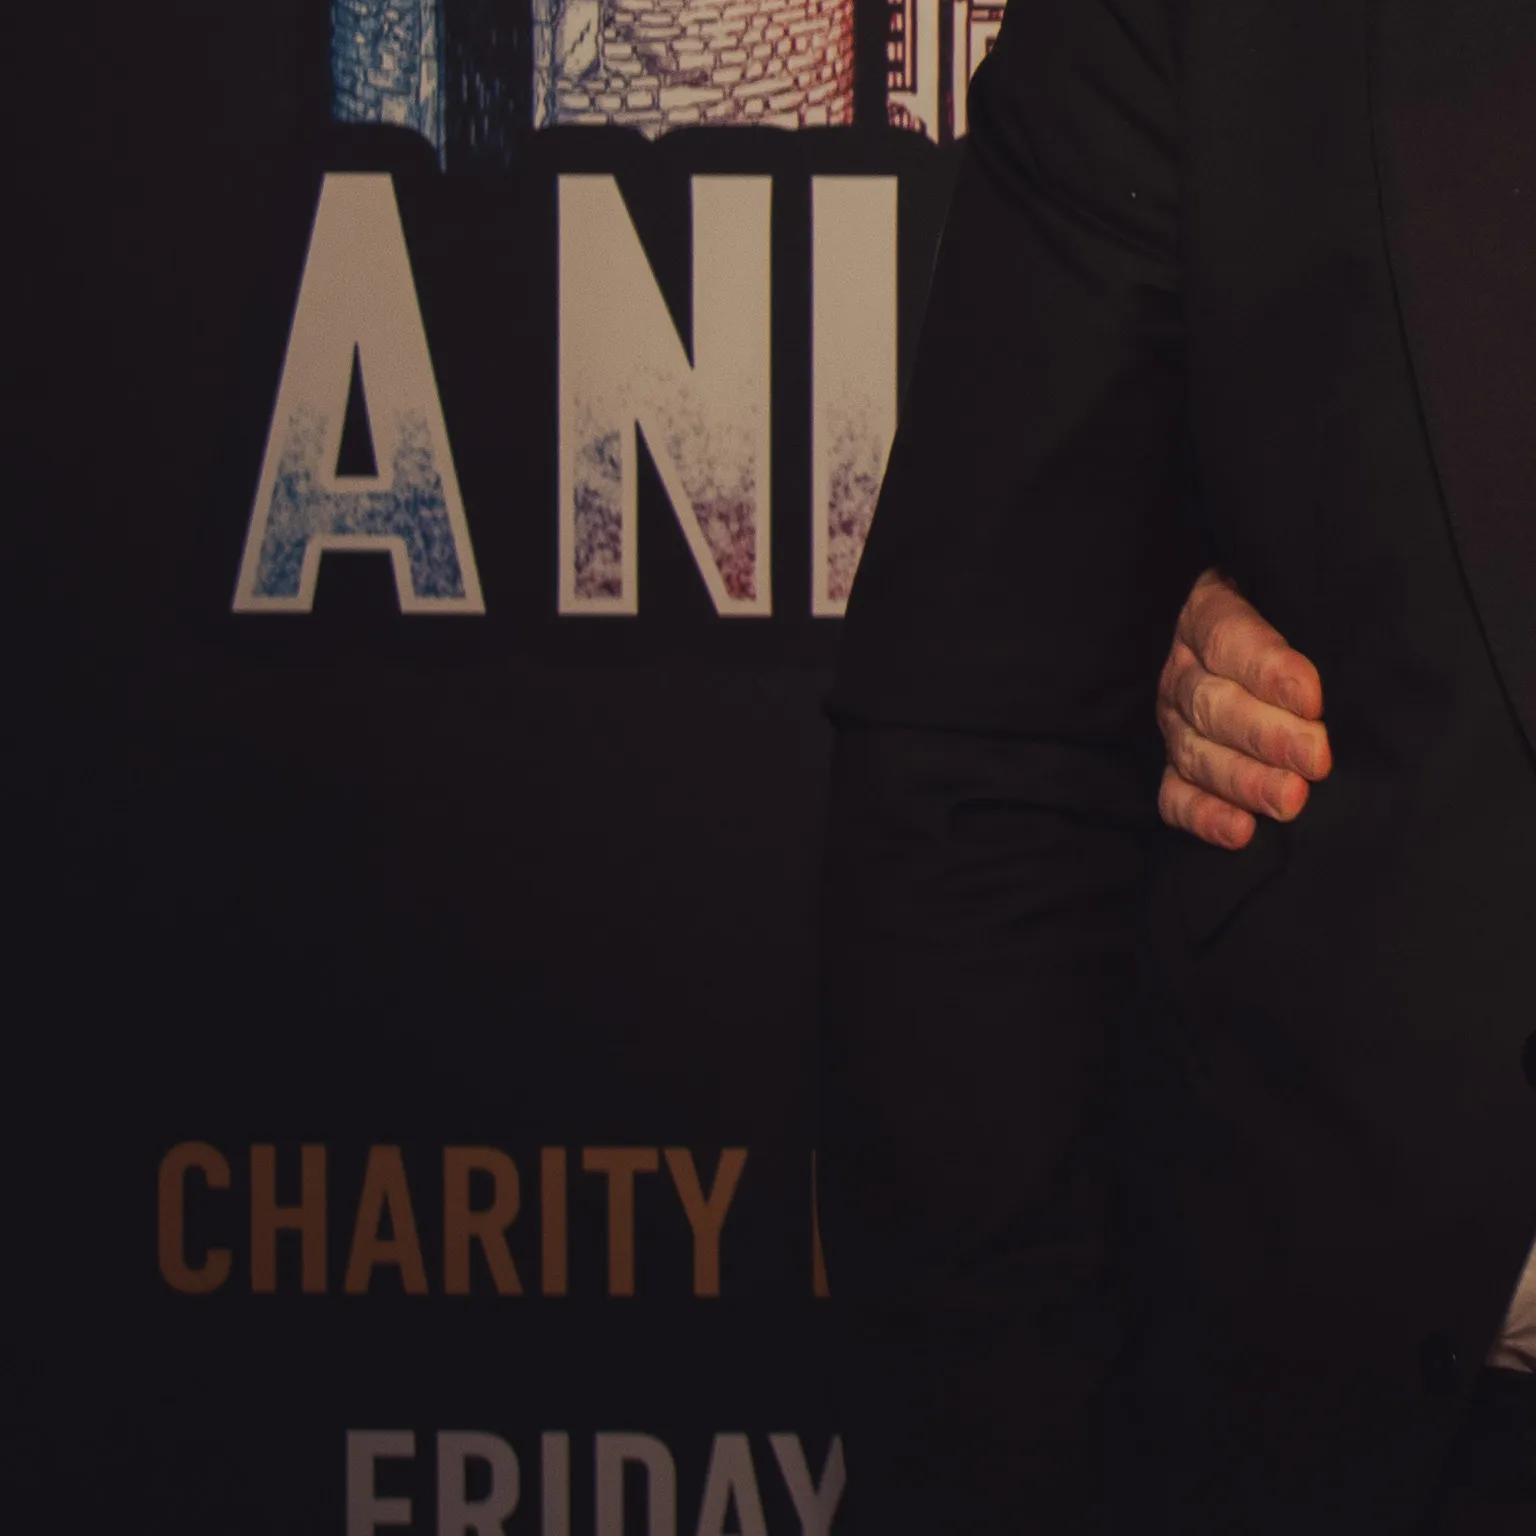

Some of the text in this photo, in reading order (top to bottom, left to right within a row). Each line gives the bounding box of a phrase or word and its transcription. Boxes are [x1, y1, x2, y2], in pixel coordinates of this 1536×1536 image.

[231, 170, 487, 614] A
[157, 1140, 750, 1298] CHARITY
[345, 1428, 848, 1536] FRIDAY
